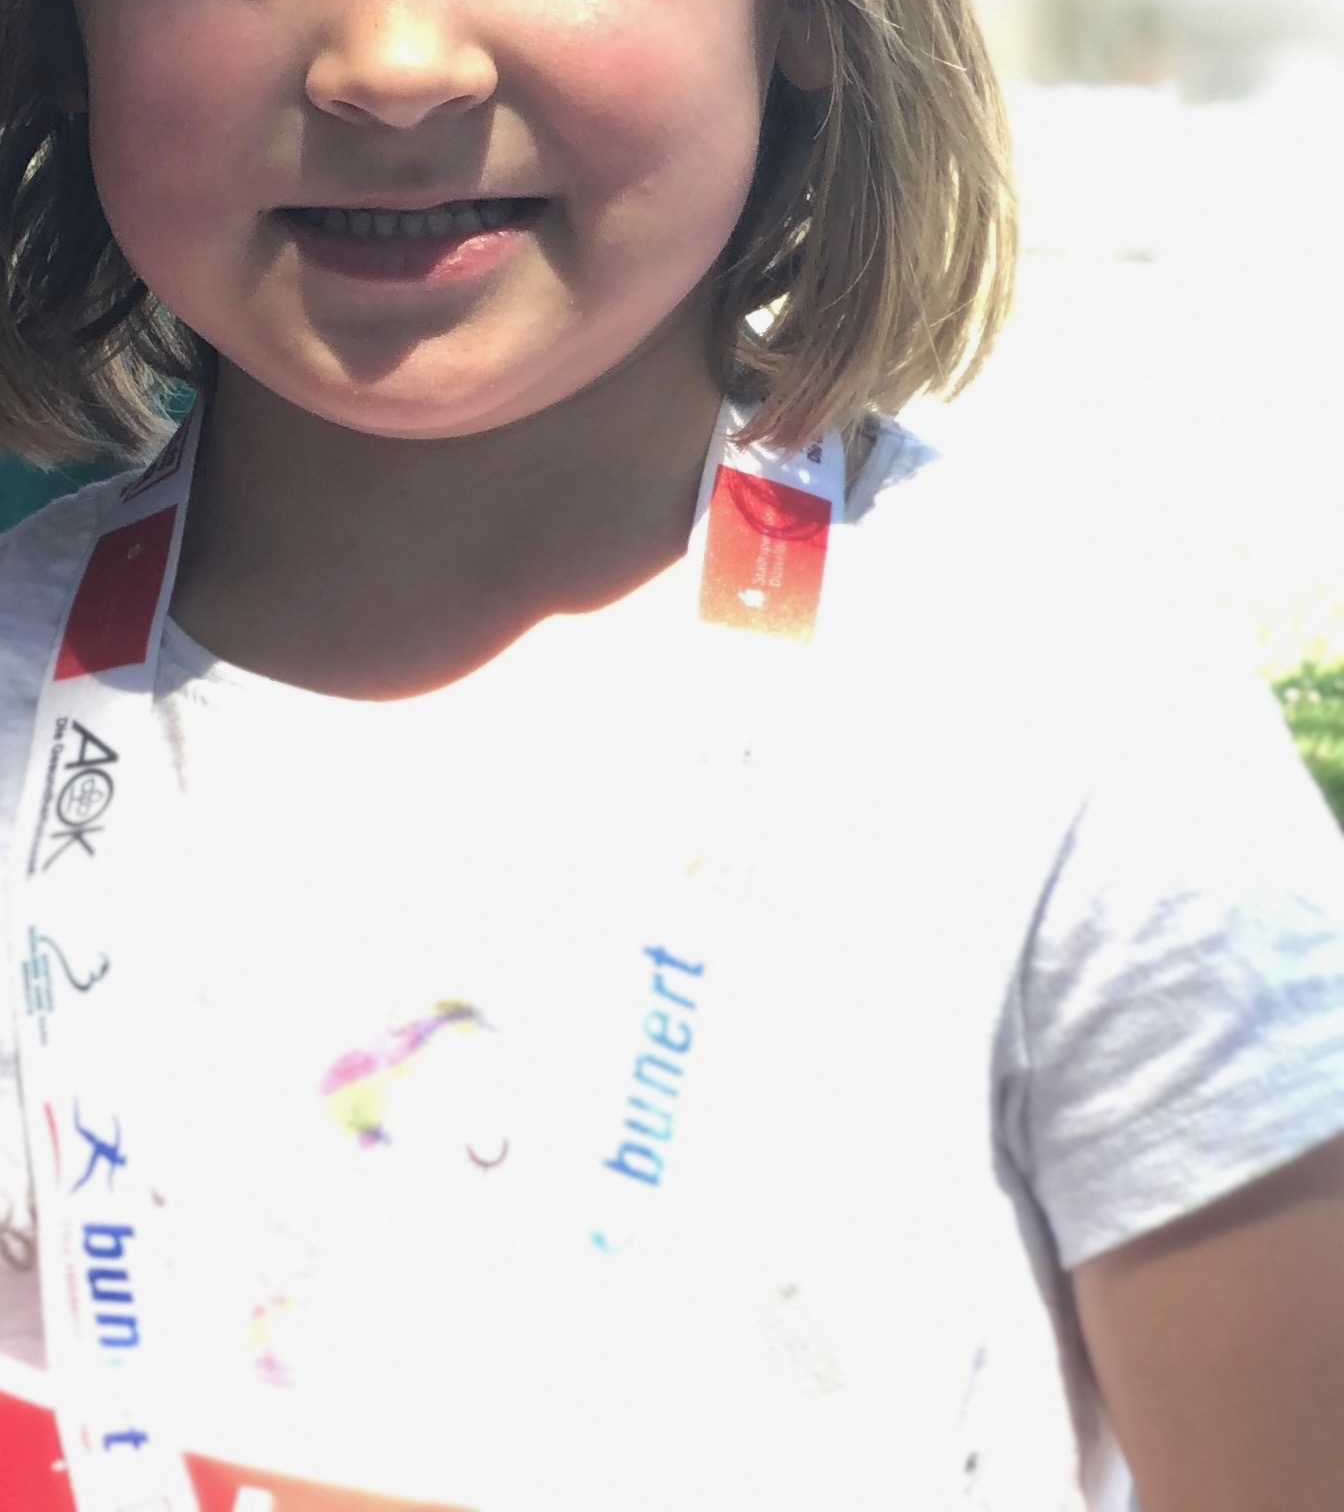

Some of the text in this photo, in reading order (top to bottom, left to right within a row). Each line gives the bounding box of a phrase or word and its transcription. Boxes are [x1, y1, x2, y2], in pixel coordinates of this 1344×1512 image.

[42, 719, 119, 872] AOK
[602, 945, 706, 1187] bunert
[82, 1222, 150, 1452] bunt
